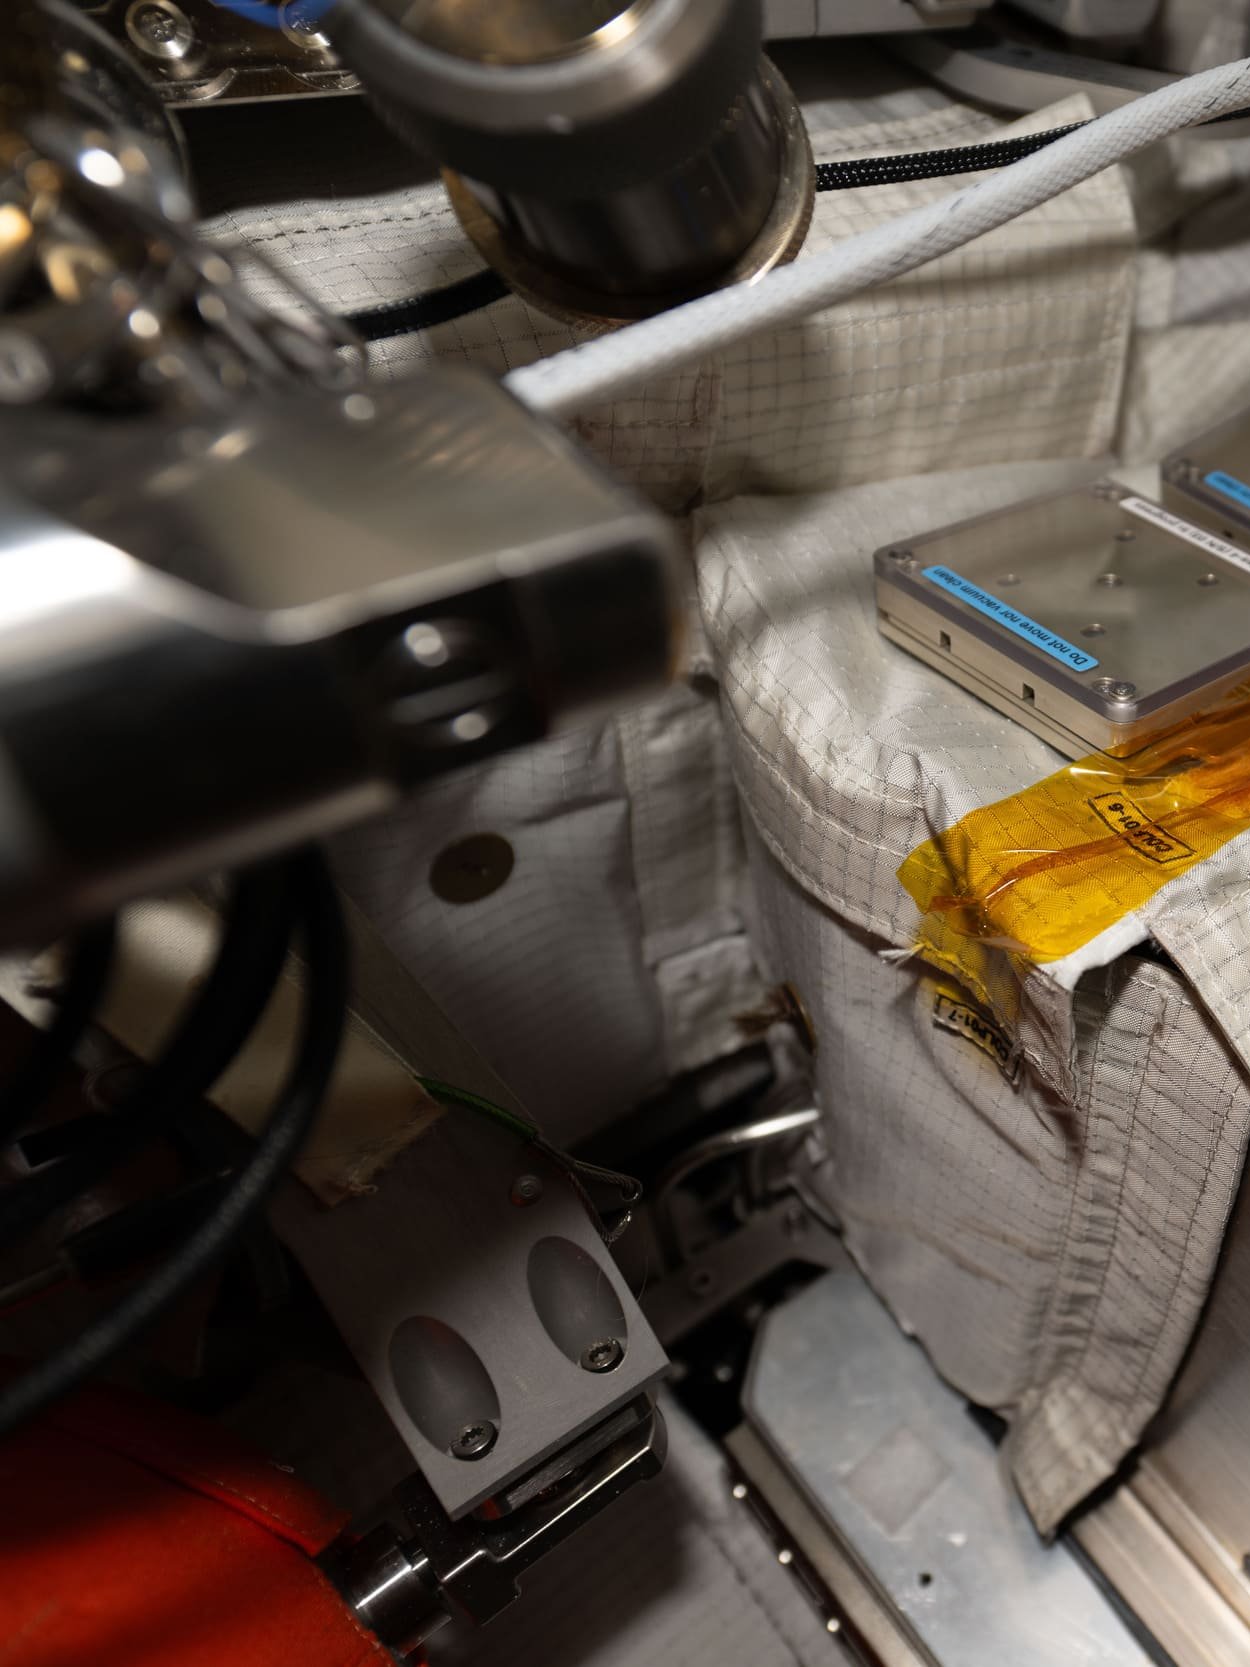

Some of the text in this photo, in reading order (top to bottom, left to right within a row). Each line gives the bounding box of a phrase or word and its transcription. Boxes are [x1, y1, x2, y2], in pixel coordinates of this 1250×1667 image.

[933, 567, 1089, 666] Do not move nor vacuum clean
